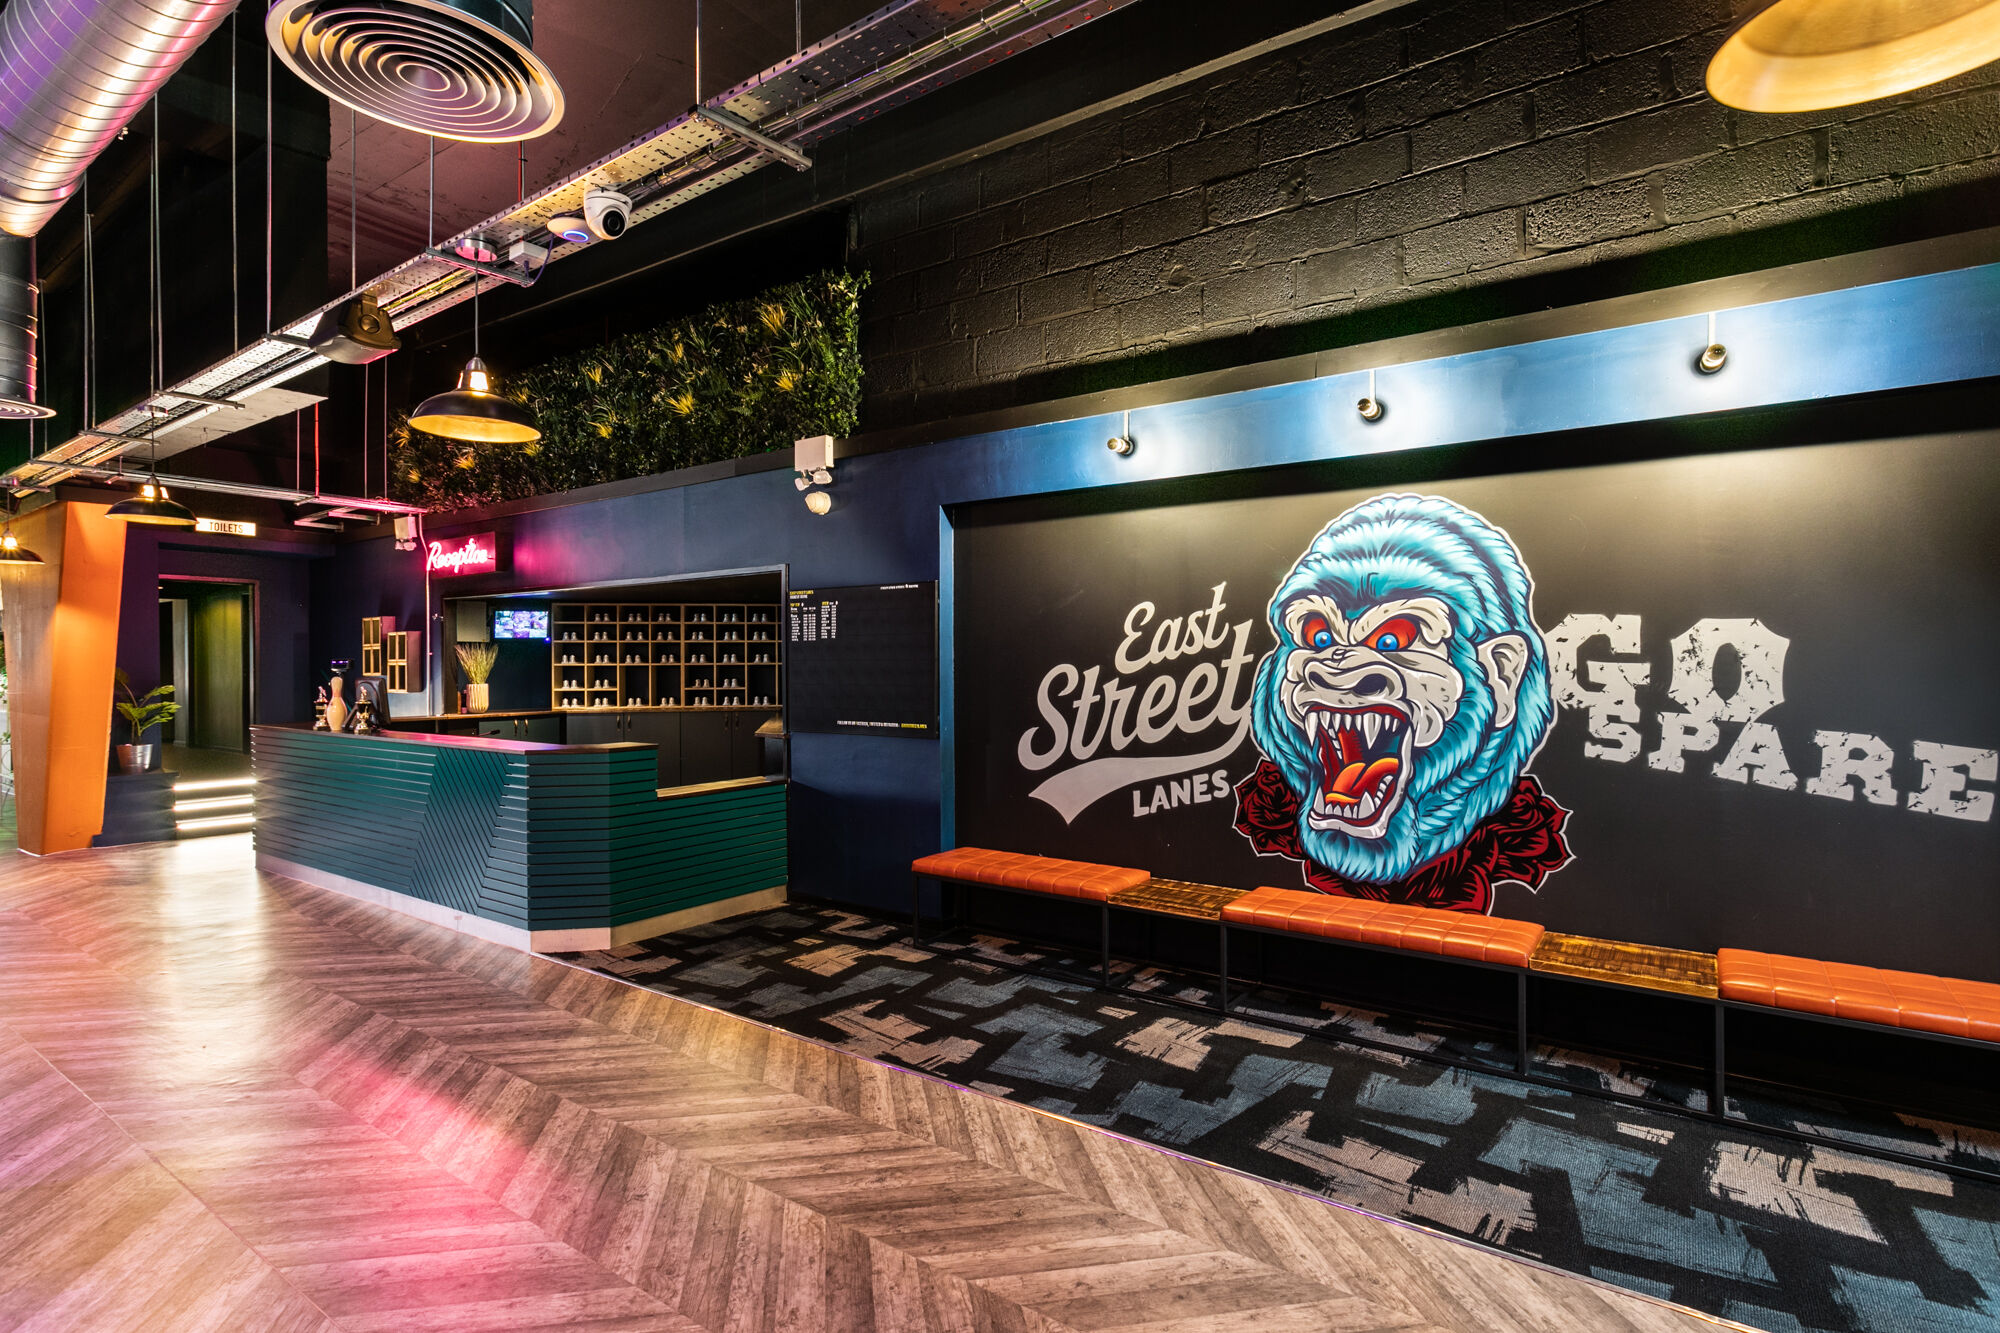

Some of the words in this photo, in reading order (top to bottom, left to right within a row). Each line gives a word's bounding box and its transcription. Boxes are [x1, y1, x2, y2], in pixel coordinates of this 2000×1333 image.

[209, 521, 244, 534] TOILETS
[427, 538, 488, 574] Reception
[1114, 581, 1229, 675] East
[1543, 613, 1790, 722] GO
[1017, 618, 1254, 771] Street
[1132, 769, 1230, 818] LANES
[1584, 701, 1999, 822] SPARE
